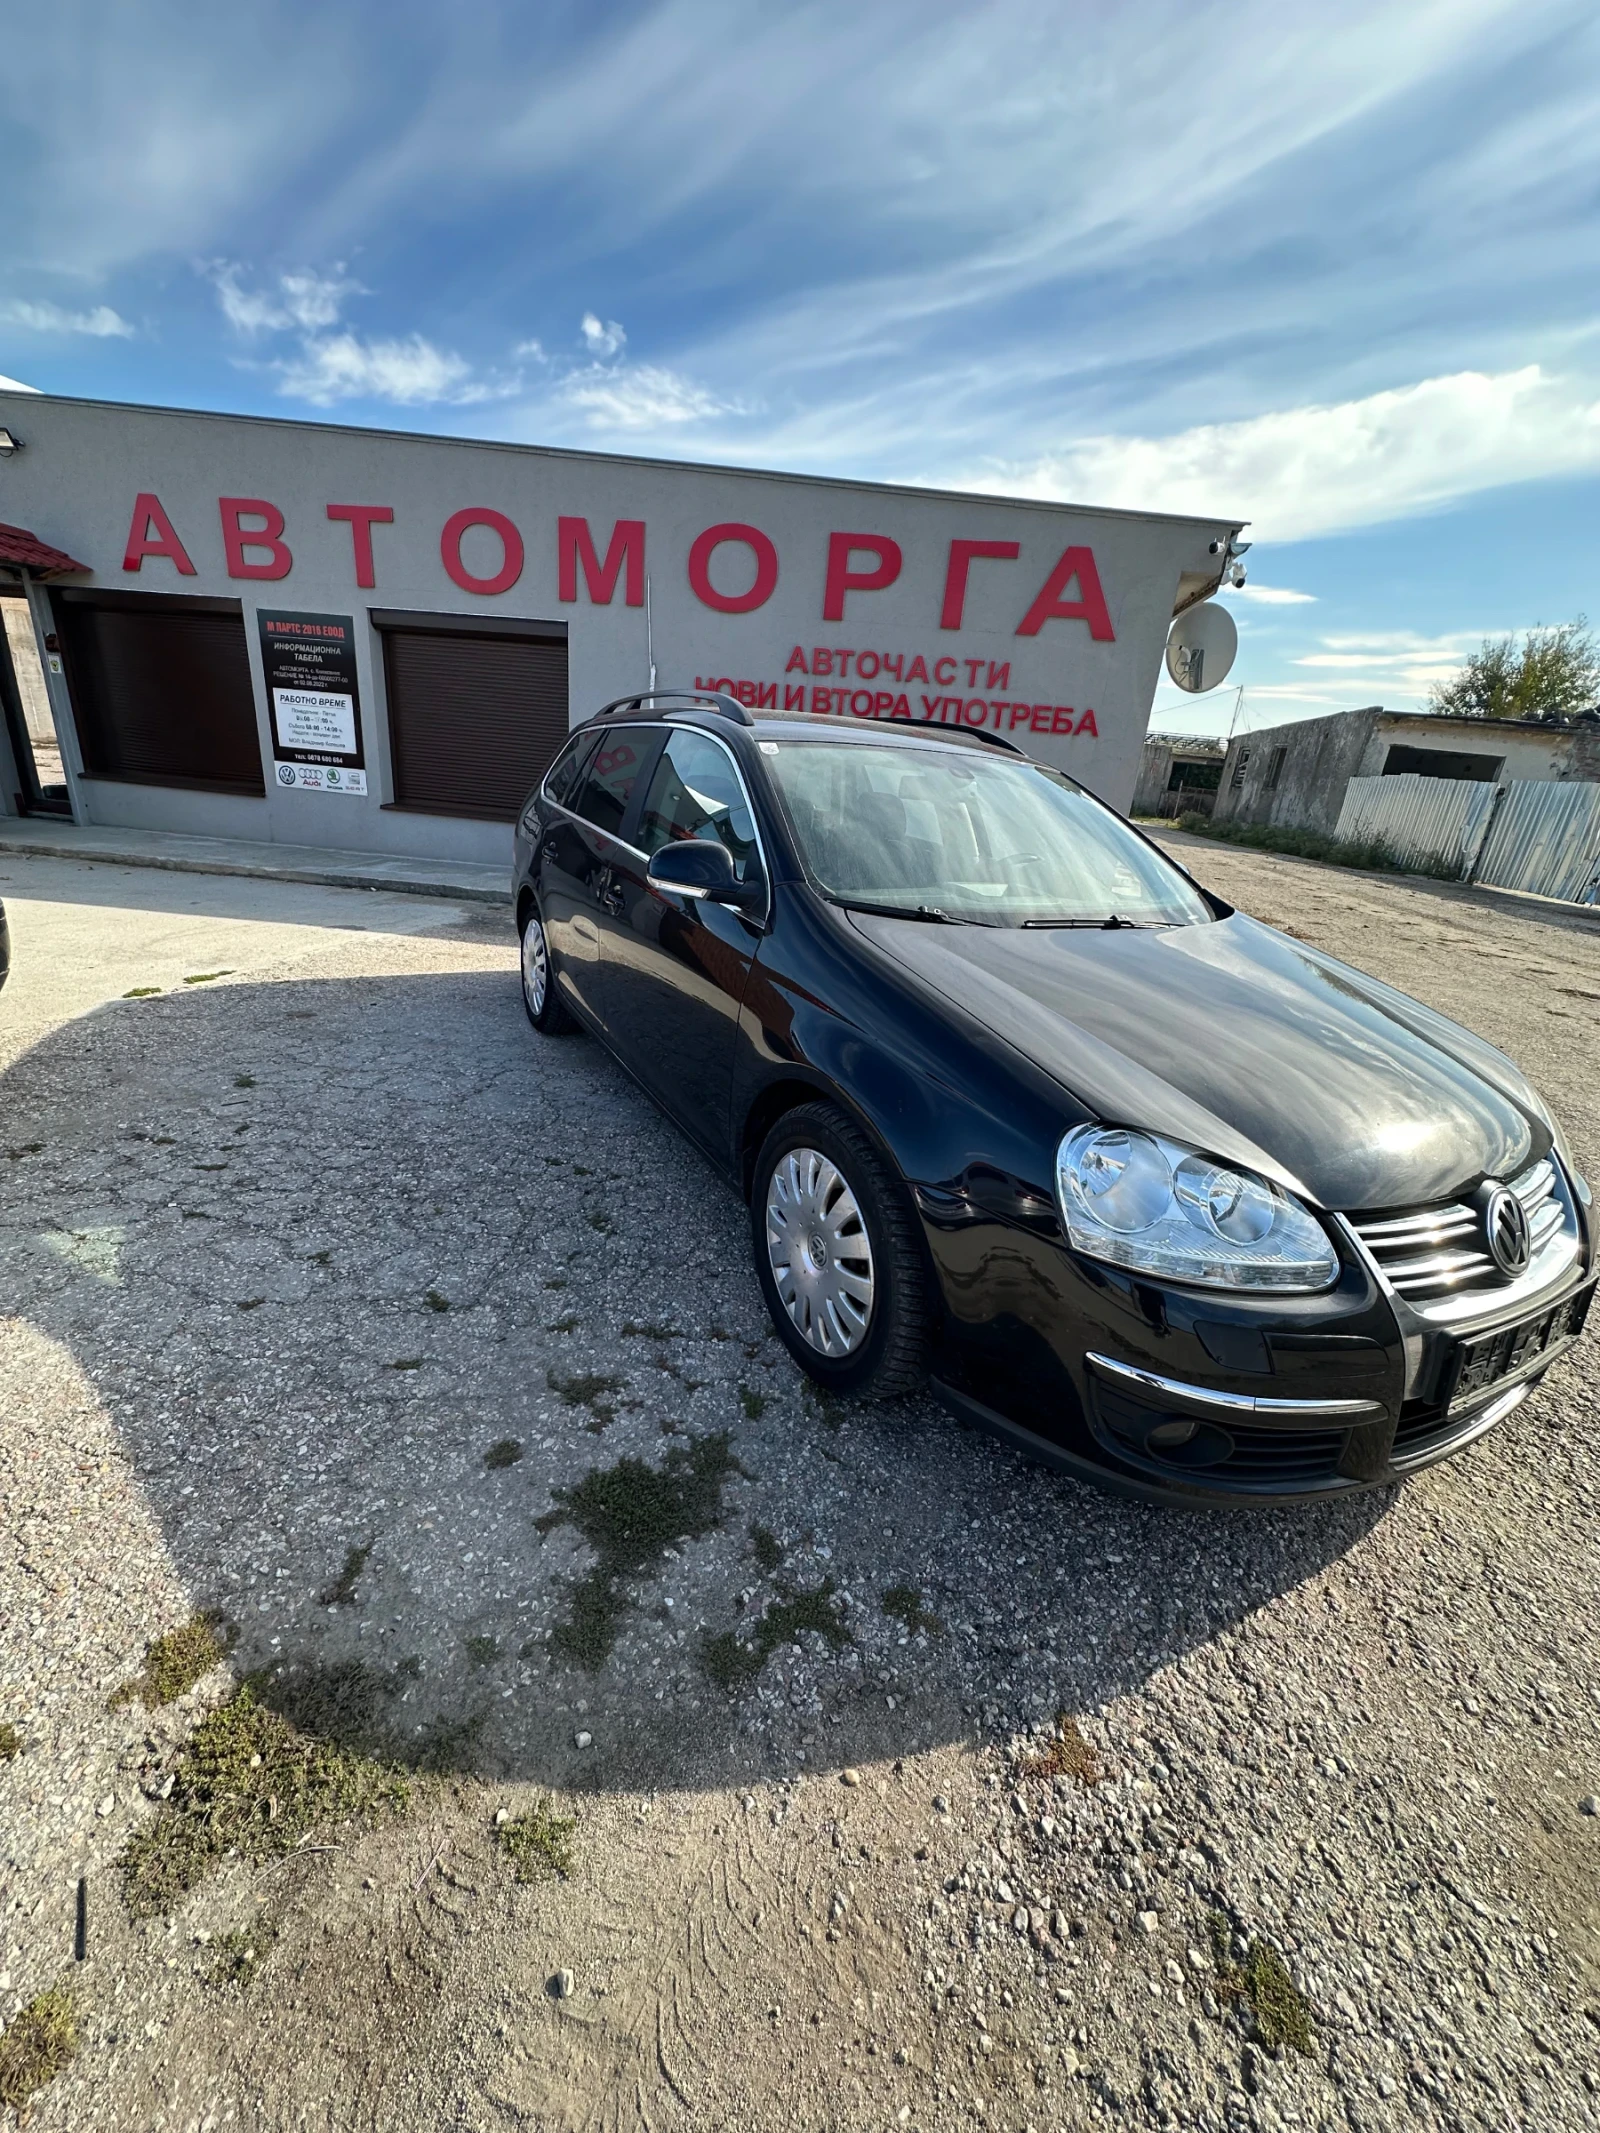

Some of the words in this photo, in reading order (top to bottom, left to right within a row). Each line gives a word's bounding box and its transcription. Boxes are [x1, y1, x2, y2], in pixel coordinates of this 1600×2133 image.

[122, 493, 1115, 642] АВТОМОРГА
[266, 621, 275, 632] М
[276, 622, 301, 634] ПАРТС
[322, 625, 345, 638] ЕООД
[274, 642, 341, 654] ИНФОРМАЦИОННА
[294, 653, 323, 663] ТАБЕЛА
[786, 646, 1011, 690] АВТОЧАСТИ
[280, 694, 317, 705] РАБОТНО
[319, 698, 346, 708] ВРЕМЕ
[785, 684, 805, 712] И
[812, 686, 911, 718] ВТОРА
[921, 695, 1099, 738] УПОТРЕБА
[303, 779, 321, 787] Audi
